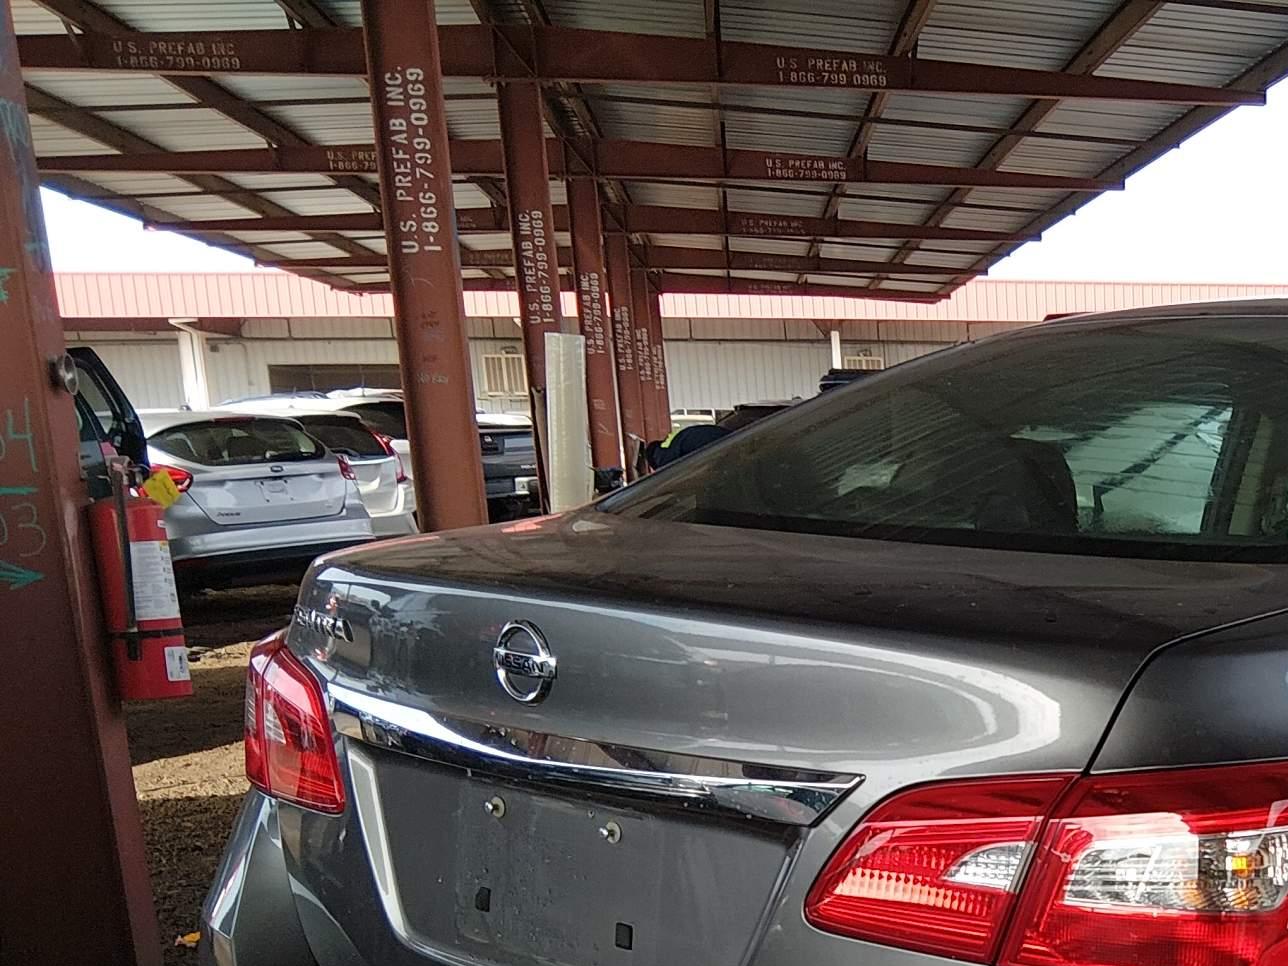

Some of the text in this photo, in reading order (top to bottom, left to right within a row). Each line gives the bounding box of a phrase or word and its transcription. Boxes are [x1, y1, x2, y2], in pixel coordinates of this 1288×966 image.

[149, 41, 205, 56] PREFAB
[807, 58, 857, 72] PREFAB
[384, 66, 420, 254] U.S. PREFAB INC.
[406, 67, 442, 252] 1-866-799-0969
[788, 160, 825, 169] PREFAB
[828, 161, 847, 170] INC.
[519, 209, 541, 324] U.S. PREFAB INC.
[531, 210, 555, 323] 1-866-799-0969
[582, 294, 594, 332] PREFAB
[496, 651, 545, 674] NISSAN
